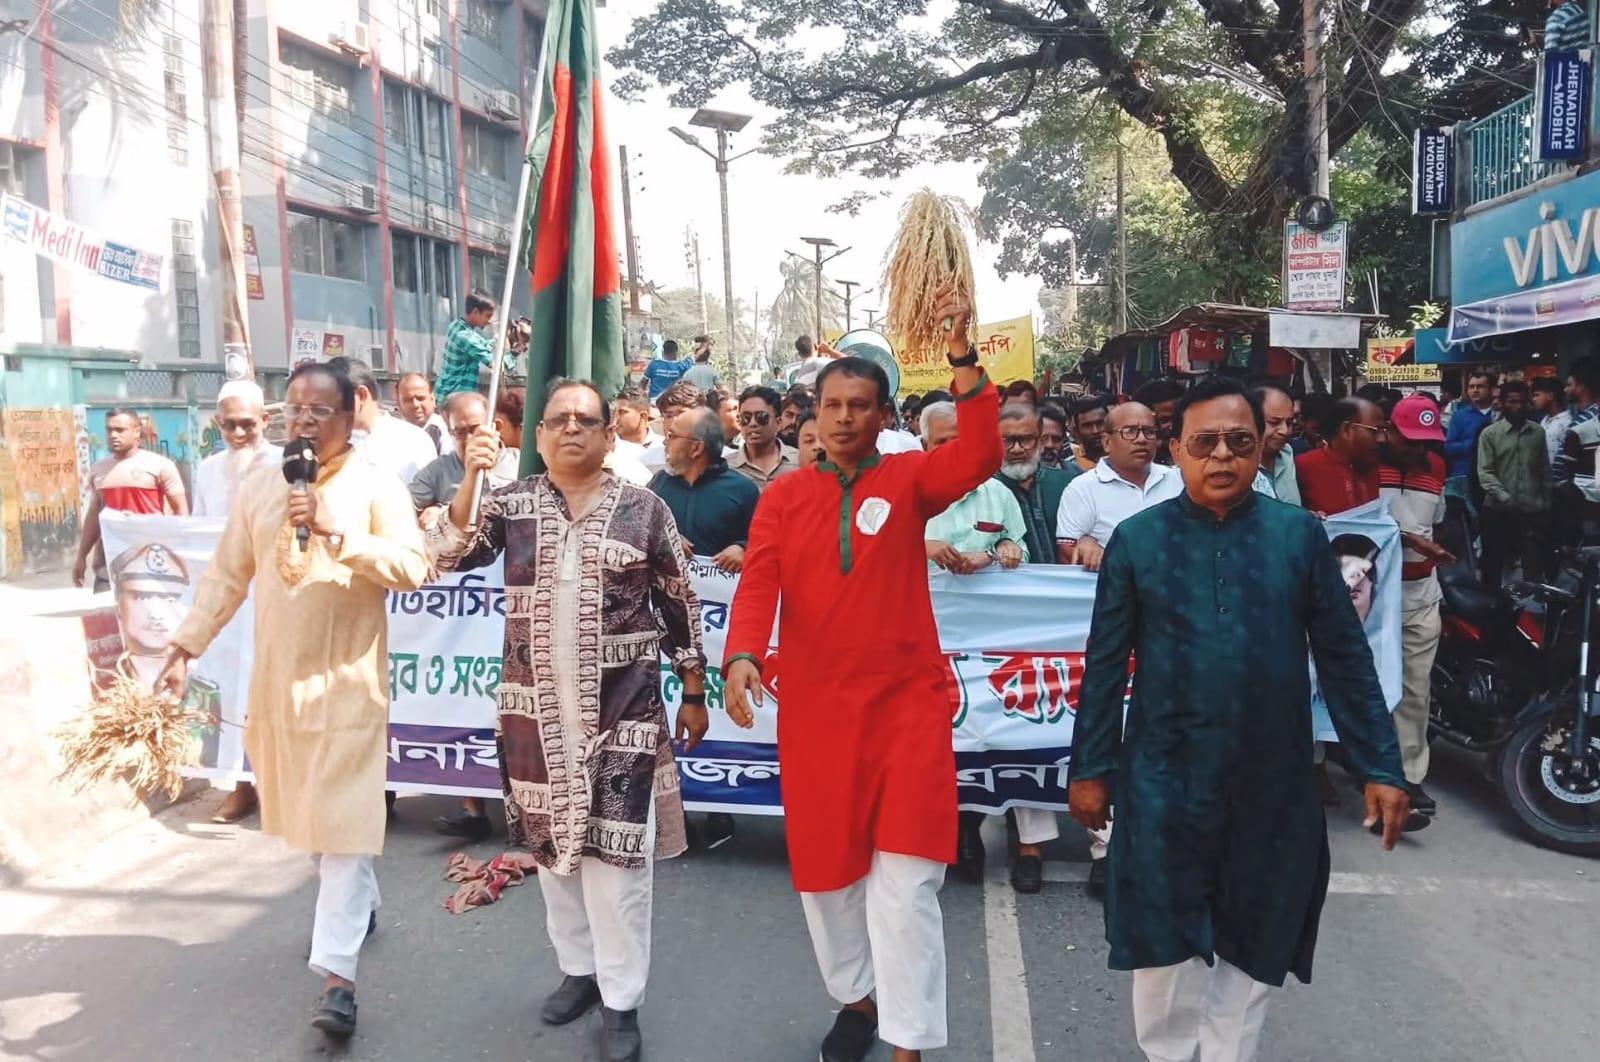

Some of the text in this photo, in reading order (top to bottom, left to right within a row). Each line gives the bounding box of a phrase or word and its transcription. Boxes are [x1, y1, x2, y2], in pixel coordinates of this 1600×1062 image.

[1551, 92, 1564, 150] MOBILE
[1564, 61, 1579, 149] JHENAIDAH
[1425, 136, 1435, 205] JHENAIDAH
[1436, 136, 1446, 182] MOBILE
[31, 209, 75, 260] Medi
[1503, 199, 1600, 288] viv
[977, 334, 1011, 356] নপি
